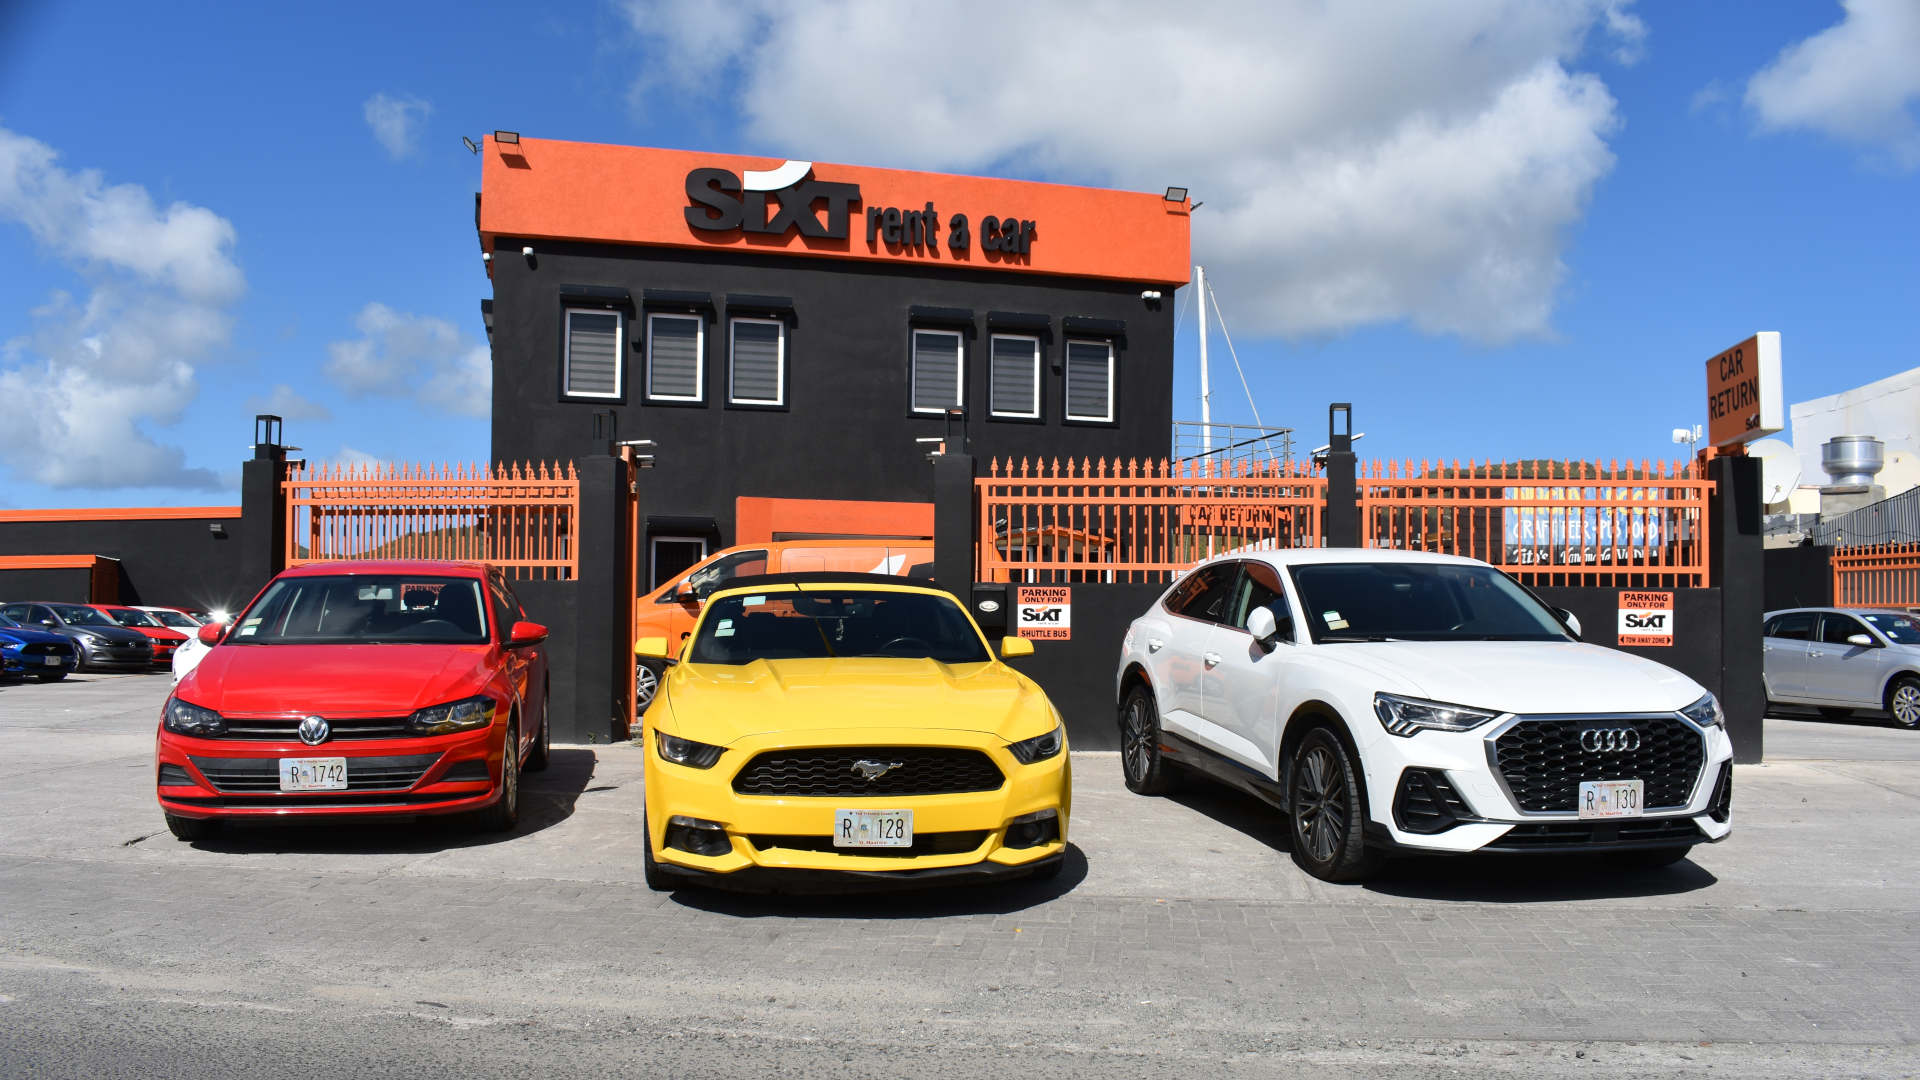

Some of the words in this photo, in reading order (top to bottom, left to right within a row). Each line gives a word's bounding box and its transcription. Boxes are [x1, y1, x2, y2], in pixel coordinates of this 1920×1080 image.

[866, 202, 938, 247] rent
[949, 212, 969, 249] a
[980, 215, 1035, 255] car
[1720, 348, 1744, 381] CAR
[1710, 376, 1758, 421] RETURN
[1022, 589, 1067, 597] PARKING
[1624, 593, 1669, 602] PARKING
[1021, 630, 1051, 638] SHUTTLE
[1053, 630, 1067, 638] BUS
[291, 766, 299, 783] R
[312, 765, 344, 783] 1742
[1586, 790, 1594, 811] R
[1615, 789, 1637, 809] 130
[843, 818, 852, 838] R
[878, 818, 904, 839] 128
